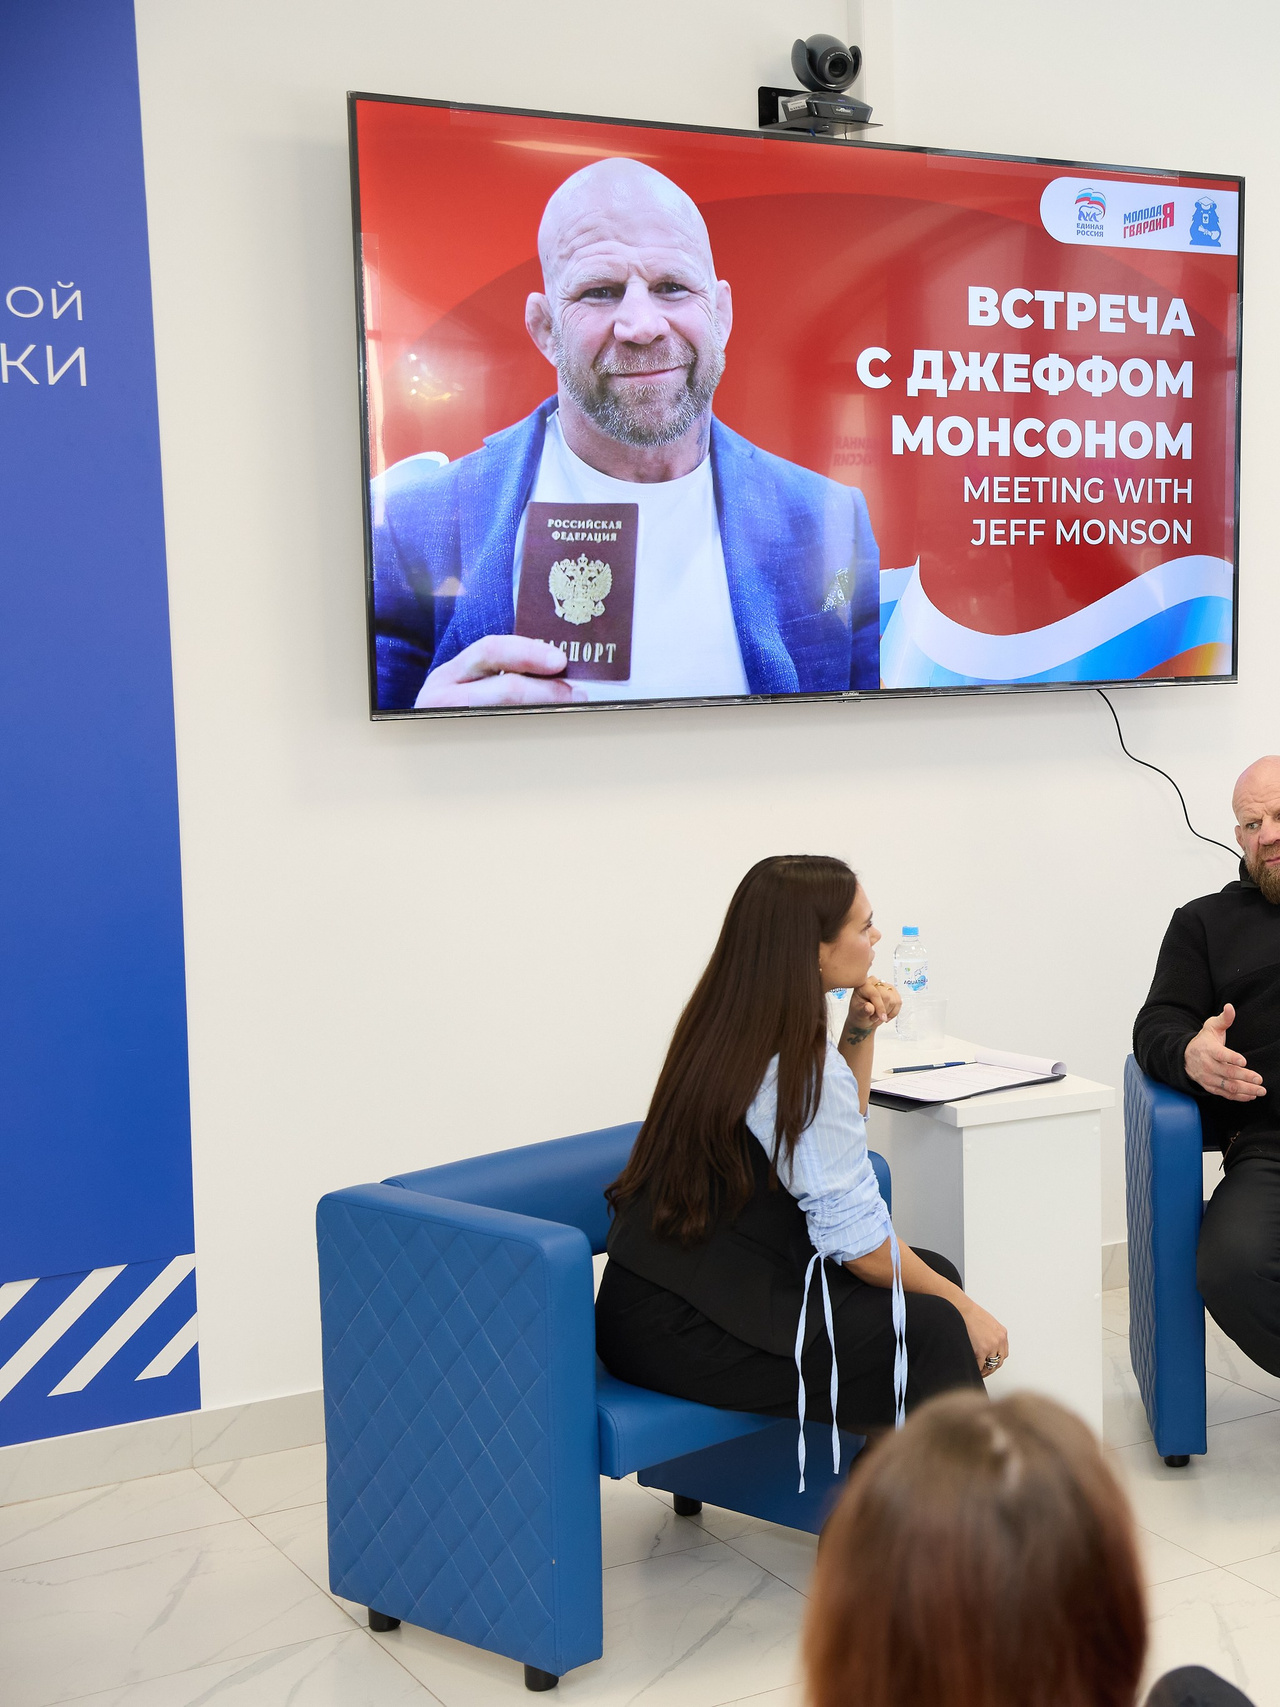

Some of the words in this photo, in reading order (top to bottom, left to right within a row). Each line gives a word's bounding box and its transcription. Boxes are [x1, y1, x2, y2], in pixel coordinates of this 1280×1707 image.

[968, 286, 1196, 337] ВСТРЕЧА
[856, 346, 892, 389] С
[907, 349, 1193, 398] ДЖЕФФОМ
[892, 415, 1192, 460] МОНСОНОМ
[964, 476, 1104, 504] MEETING
[1114, 478, 1192, 504] WITH
[547, 518, 622, 530] РОССИЙСКАЯ
[551, 530, 617, 543] ФЕДЕРАЦИЯ
[970, 519, 1046, 546] JEFF
[1056, 519, 1192, 545] MONSON
